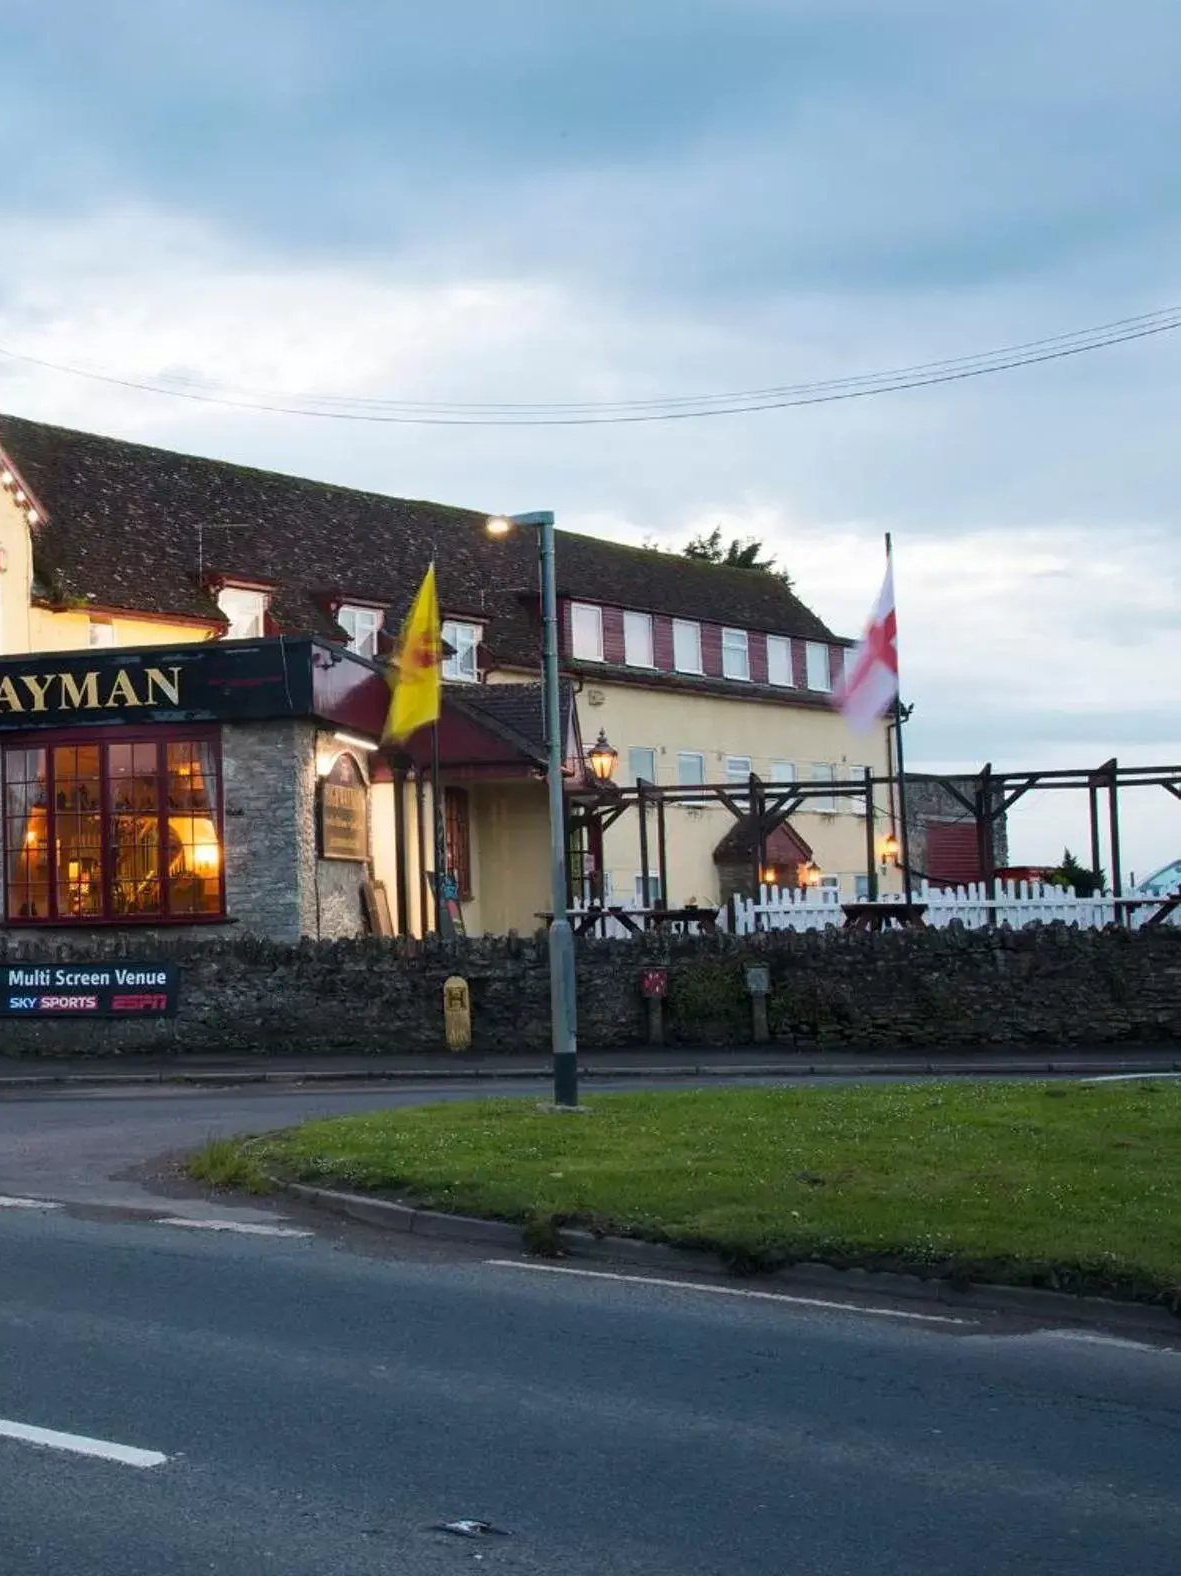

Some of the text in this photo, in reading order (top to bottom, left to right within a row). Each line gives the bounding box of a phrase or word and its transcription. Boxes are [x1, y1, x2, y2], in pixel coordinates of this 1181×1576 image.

[8, 969, 167, 986] Multi Screen Venue
[9, 995, 167, 1009] SKY SPORTS ESPN
